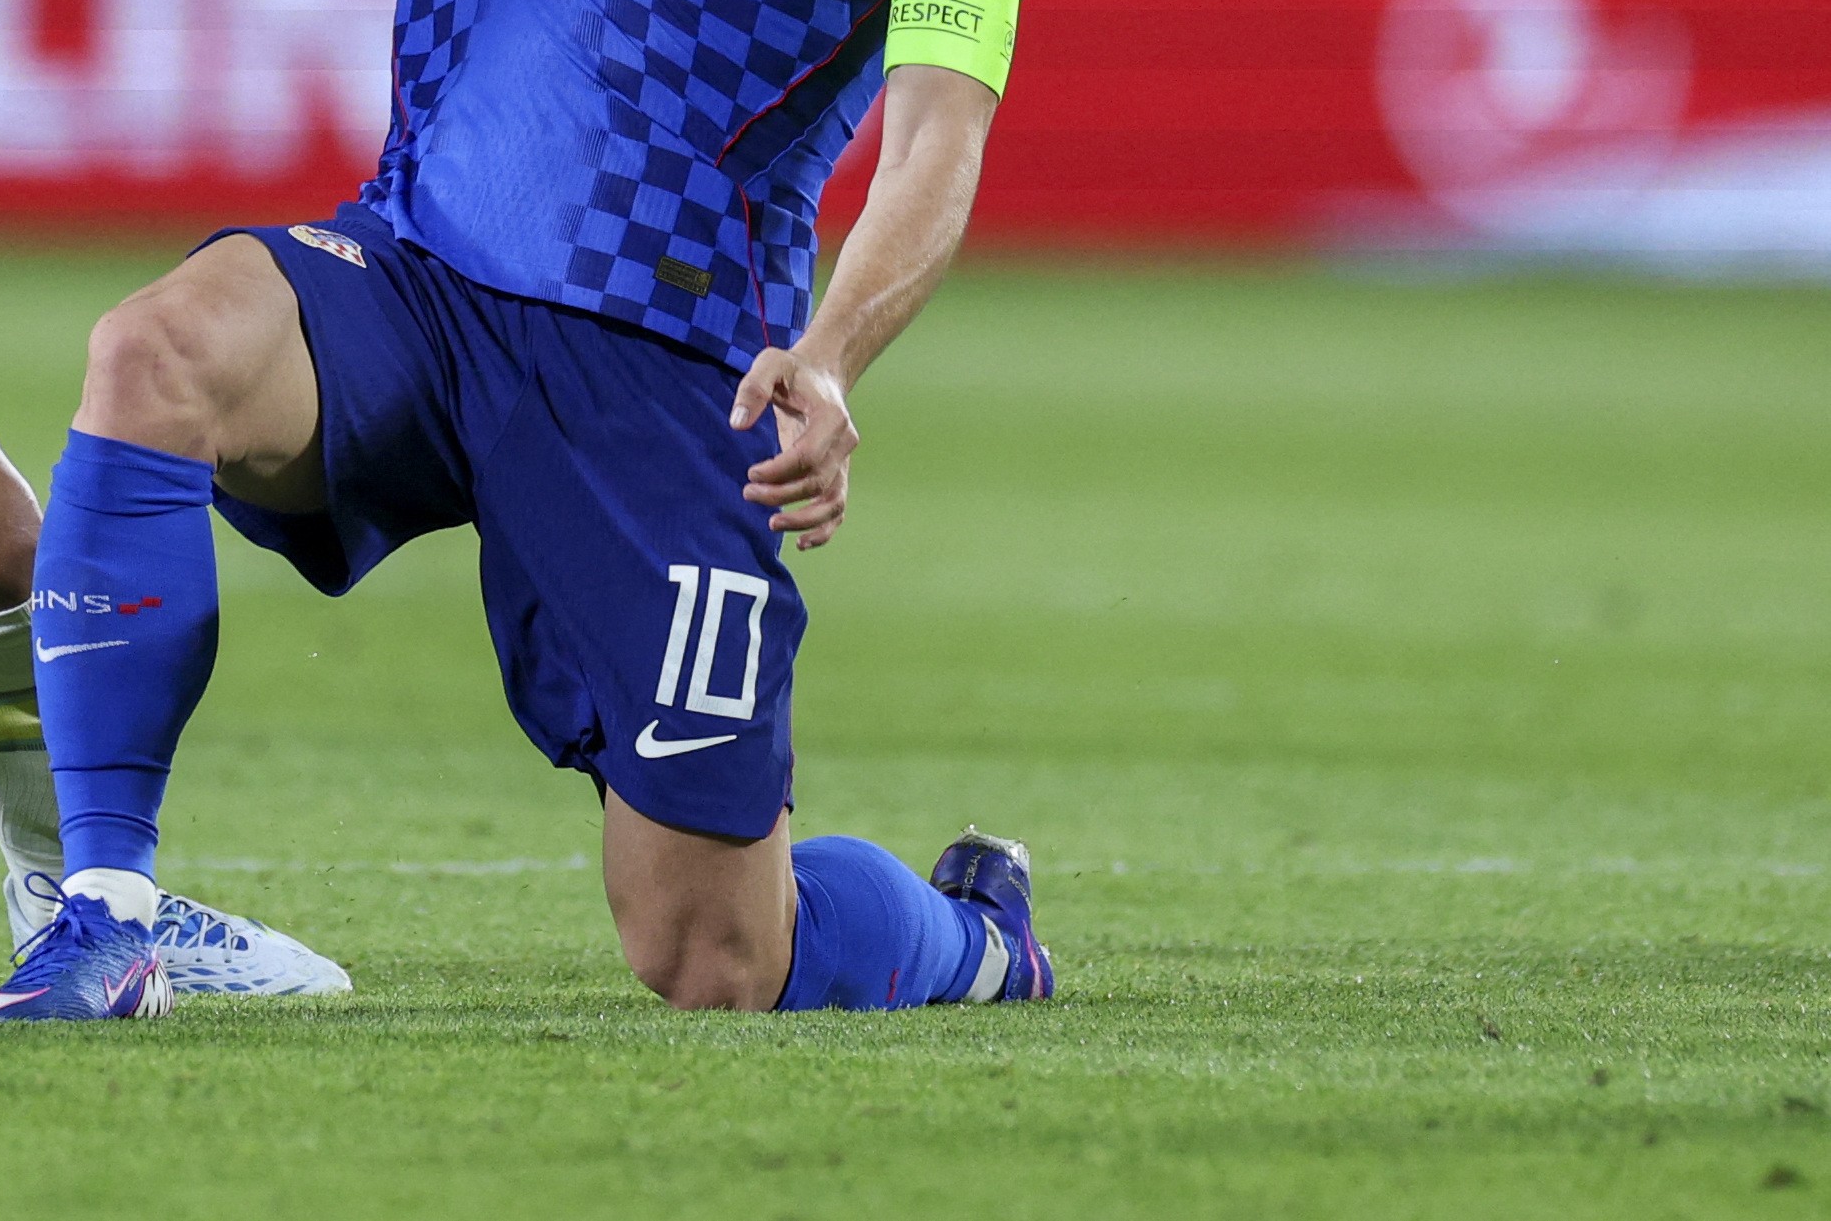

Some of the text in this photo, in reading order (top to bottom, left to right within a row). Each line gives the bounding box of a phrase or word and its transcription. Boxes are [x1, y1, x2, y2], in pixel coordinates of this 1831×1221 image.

[890, 2, 983, 34] RESPECT
[31, 590, 112, 615] HNS
[655, 564, 770, 721] 10
